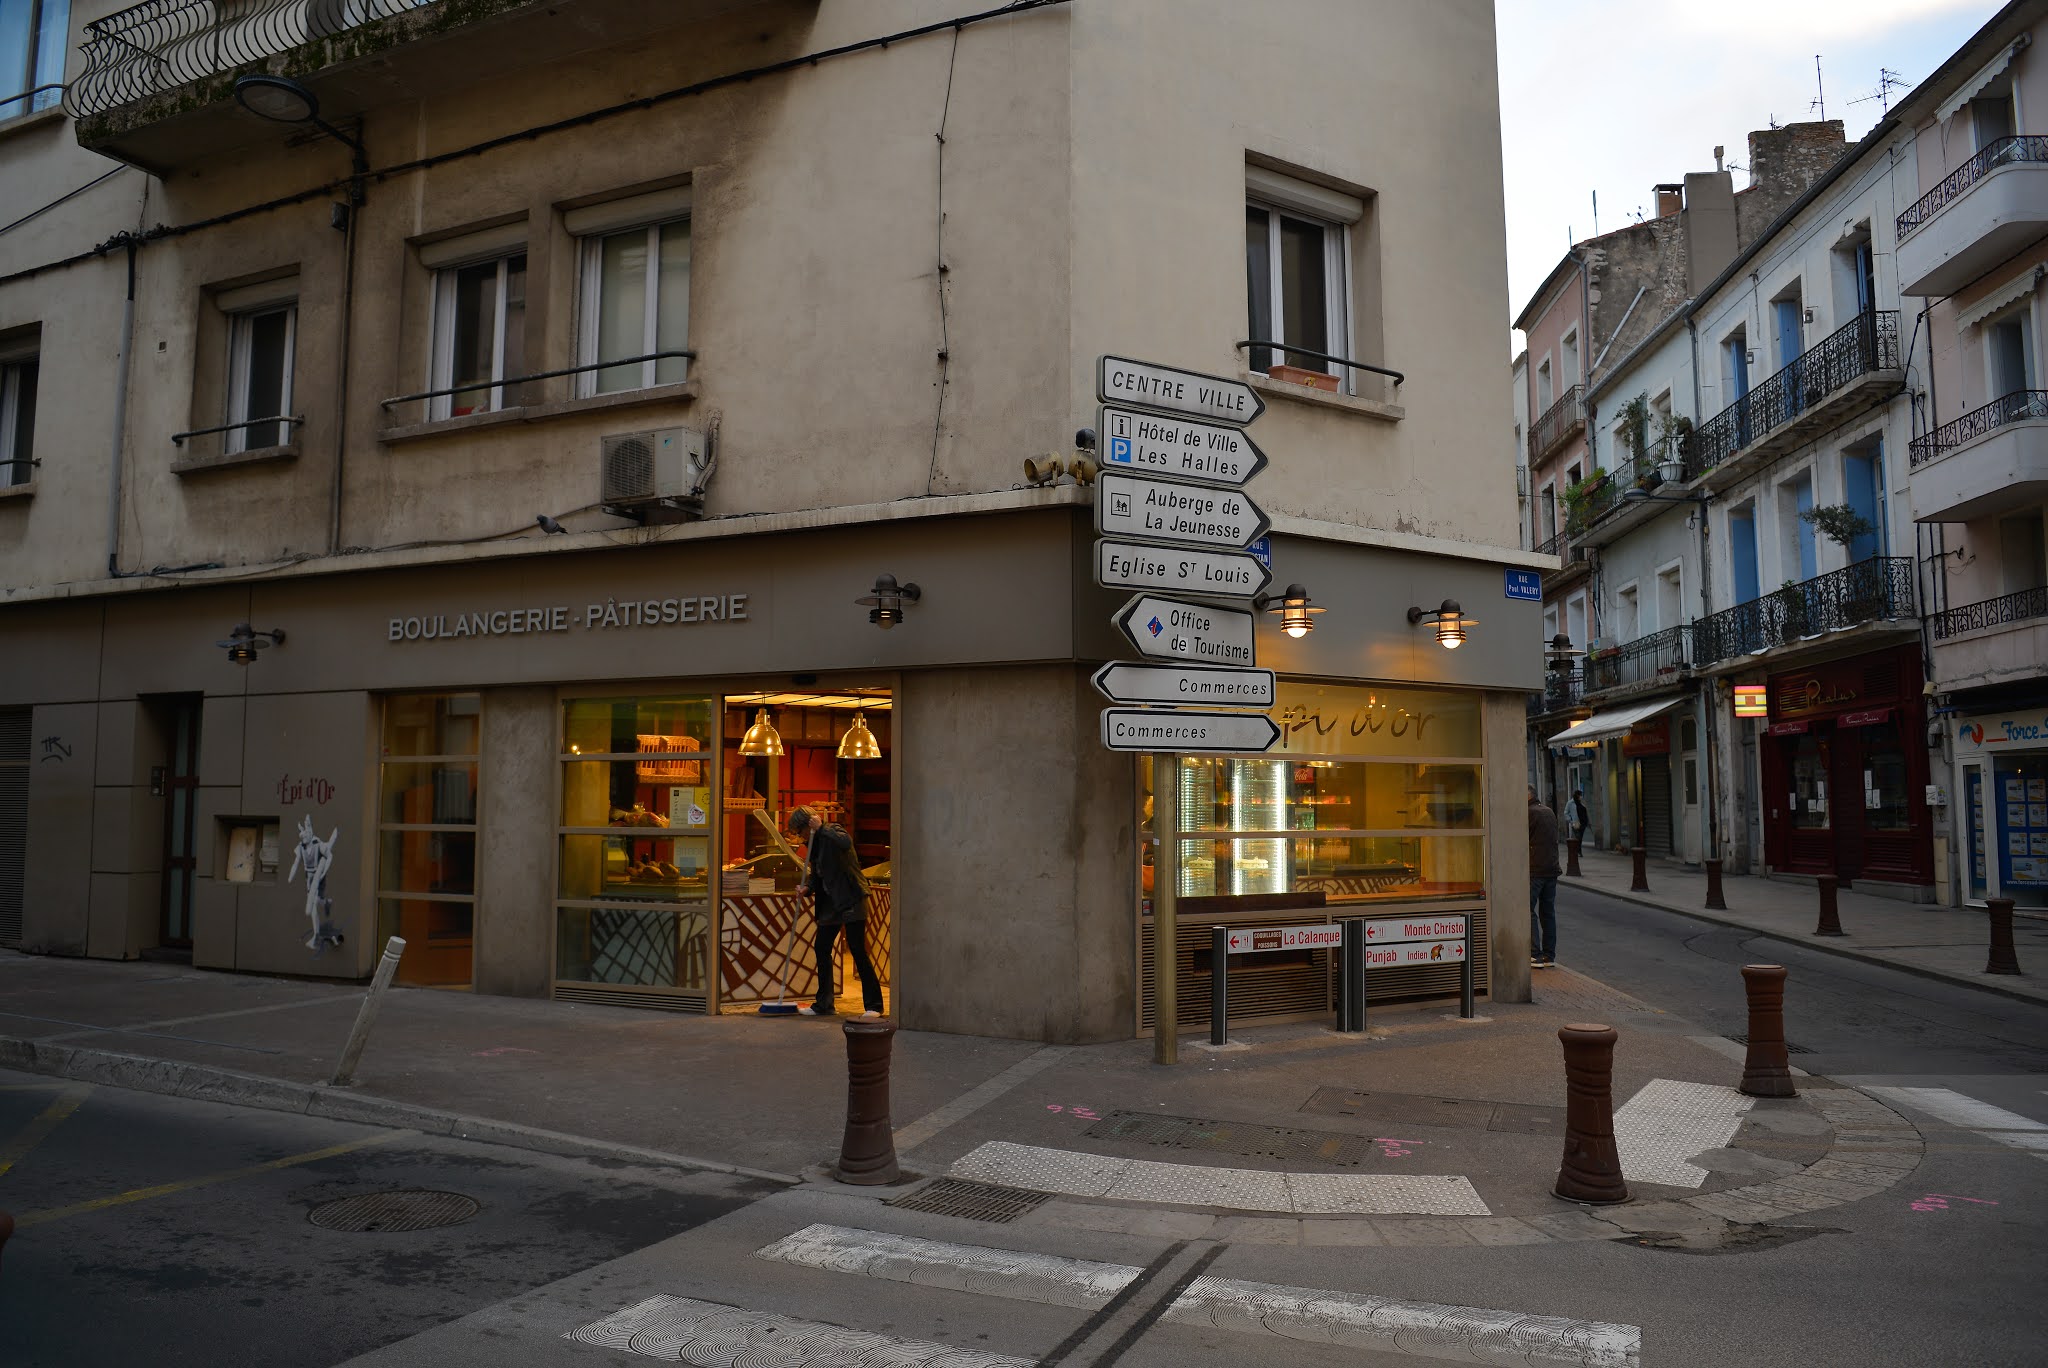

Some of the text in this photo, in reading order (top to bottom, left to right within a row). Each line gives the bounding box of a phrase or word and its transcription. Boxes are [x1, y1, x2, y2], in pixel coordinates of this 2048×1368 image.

[1112, 371, 1245, 411] CENTRE VILLE
[1138, 421, 1238, 453] Hôtel de Ville
[1138, 445, 1238, 476] Les Halles
[1145, 488, 1240, 516] Auberge de
[1145, 511, 1240, 539] La Jeunesse
[1110, 555, 1166, 578] Eglise
[1205, 564, 1250, 584] Louis
[1518, 574, 1528, 583] RUE
[1508, 584, 1519, 593] Paul
[388, 606, 569, 641] BOULANGERIE
[586, 593, 748, 628] PÂTISSERIE
[1170, 609, 1211, 631] Office
[1171, 633, 1249, 660] de Tourisme
[1178, 678, 1267, 695] Commerces
[1115, 722, 1207, 739] Commerces
[2001, 720, 2040, 741] Force
[306, 778, 335, 805] d'Or
[1284, 930, 1340, 946] La Calanque
[1404, 921, 1464, 937] Monte Christo
[1366, 950, 1428, 965] Punjab Indien
